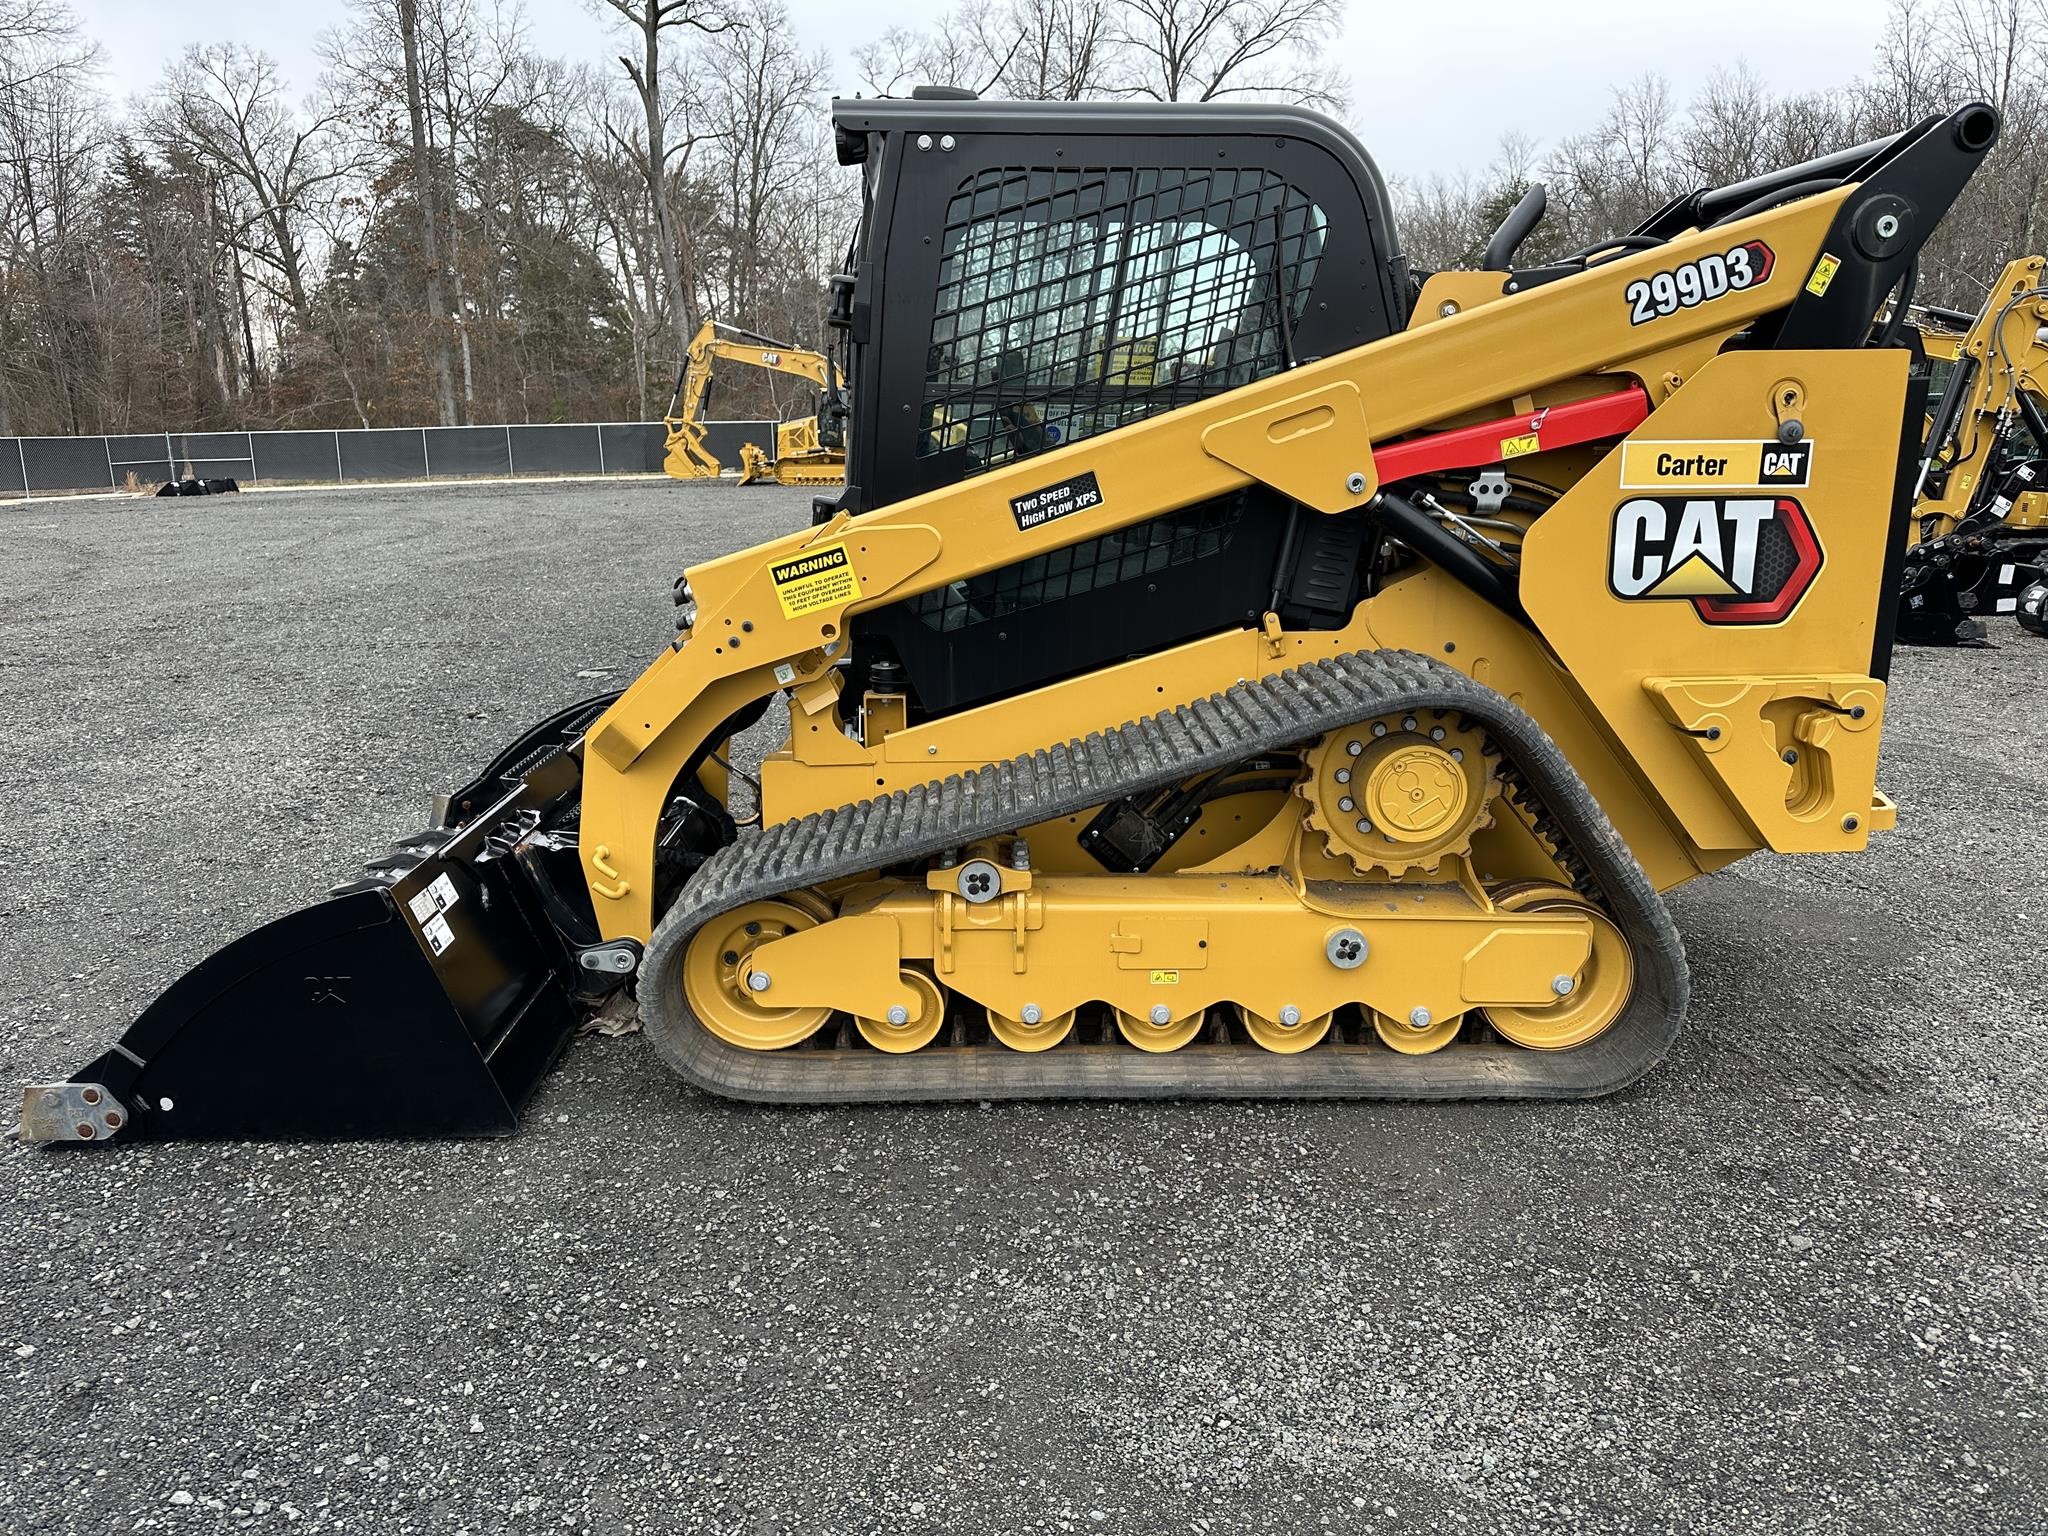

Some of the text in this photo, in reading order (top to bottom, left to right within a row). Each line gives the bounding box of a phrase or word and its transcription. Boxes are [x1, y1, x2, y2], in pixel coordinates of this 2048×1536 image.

[1627, 247, 1753, 324] 299D3
[762, 352, 778, 364] CAT
[1656, 453, 1803, 476] Carter CAT
[1075, 491, 1097, 508] XPS
[1612, 500, 1775, 596] CAT
[776, 552, 844, 581] WARNING
[783, 583, 813, 595] UNLAWFUL
[824, 572, 849, 583] OPERATE
[783, 577, 853, 602] THIS EQUIPMENT WITHIN
[796, 596, 811, 605] FEET
[812, 592, 820, 600] OF
[821, 584, 852, 597] OVERHEAD
[809, 597, 833, 607] VOLTAGE
[834, 591, 851, 599] LINES
